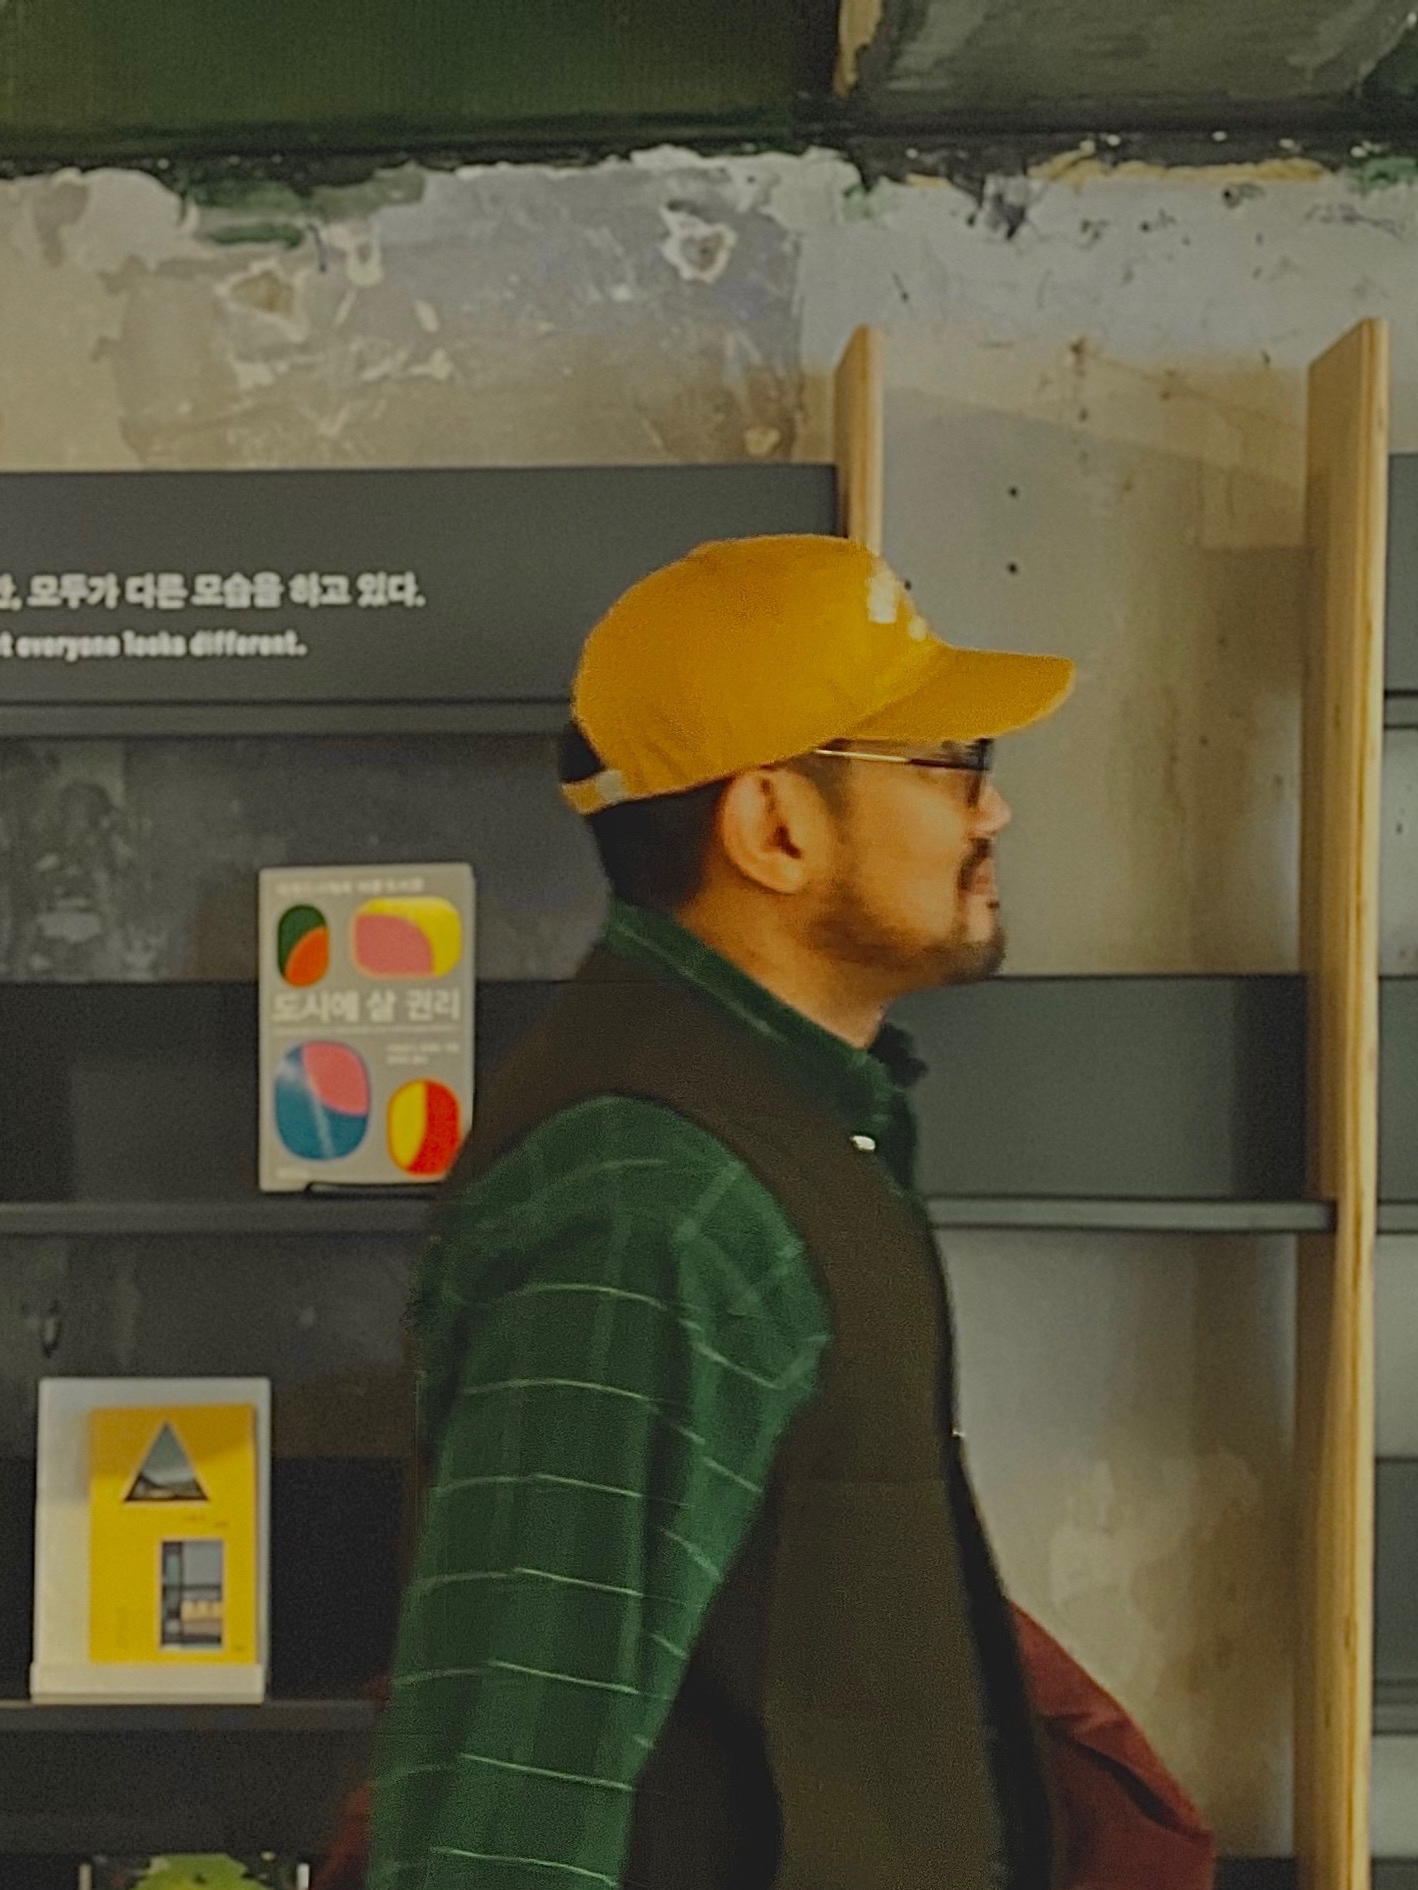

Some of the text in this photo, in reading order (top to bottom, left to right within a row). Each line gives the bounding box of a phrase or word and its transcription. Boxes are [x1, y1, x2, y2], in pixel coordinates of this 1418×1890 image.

[27, 572, 120, 609] 모두가
[125, 572, 188, 609] 다른
[190, 571, 284, 608] 모습을
[289, 571, 352, 608] 하고
[356, 570, 426, 608] 있다.
[15, 635, 121, 663] everyone
[122, 629, 187, 658] looks
[188, 628, 308, 658] different.
[272, 988, 360, 1024] 도시에
[406, 986, 461, 1021] 권리
